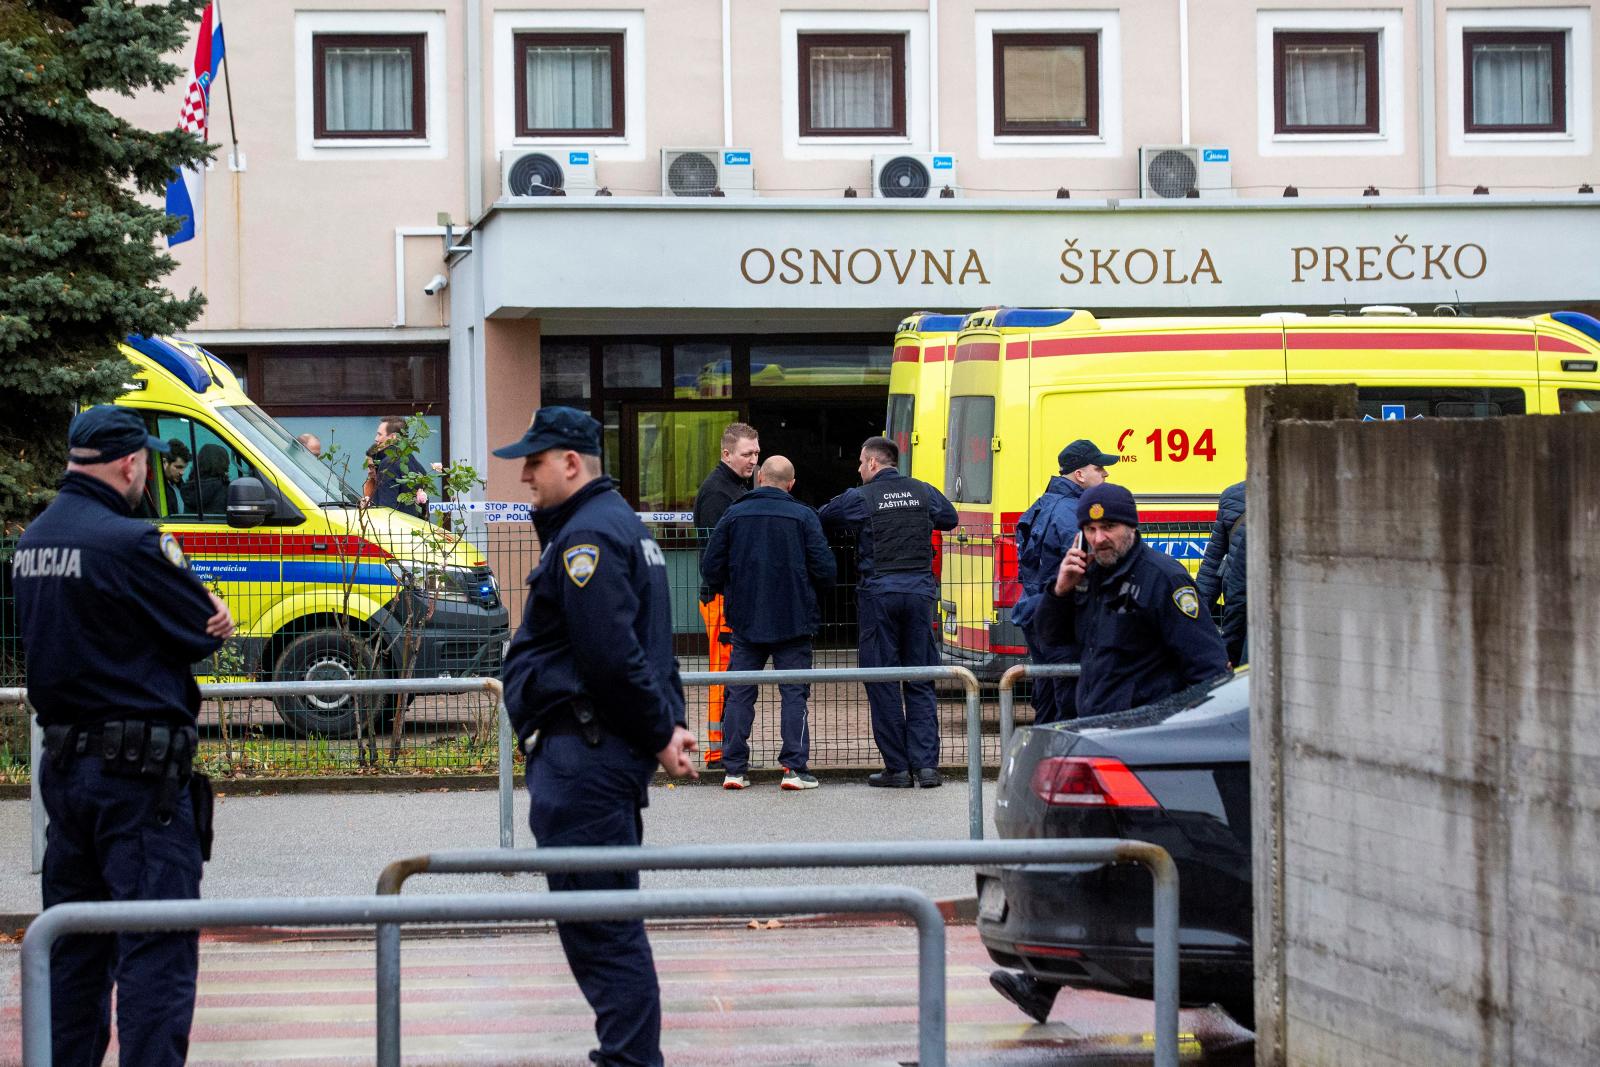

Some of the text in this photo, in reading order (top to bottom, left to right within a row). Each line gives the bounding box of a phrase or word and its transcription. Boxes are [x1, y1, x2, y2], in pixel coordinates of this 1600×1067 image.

[740, 234, 1487, 285] OSNOVNA ŠKOLA PREČKO
[1145, 428, 1217, 462] 194
[883, 491, 912, 500] CIVILNA
[429, 503, 467, 512] POLICIJA
[484, 503, 508, 511] STOP
[879, 500, 908, 509] ZAŠTITA
[653, 513, 676, 521] STOP
[12, 547, 82, 578] POLICIJA
